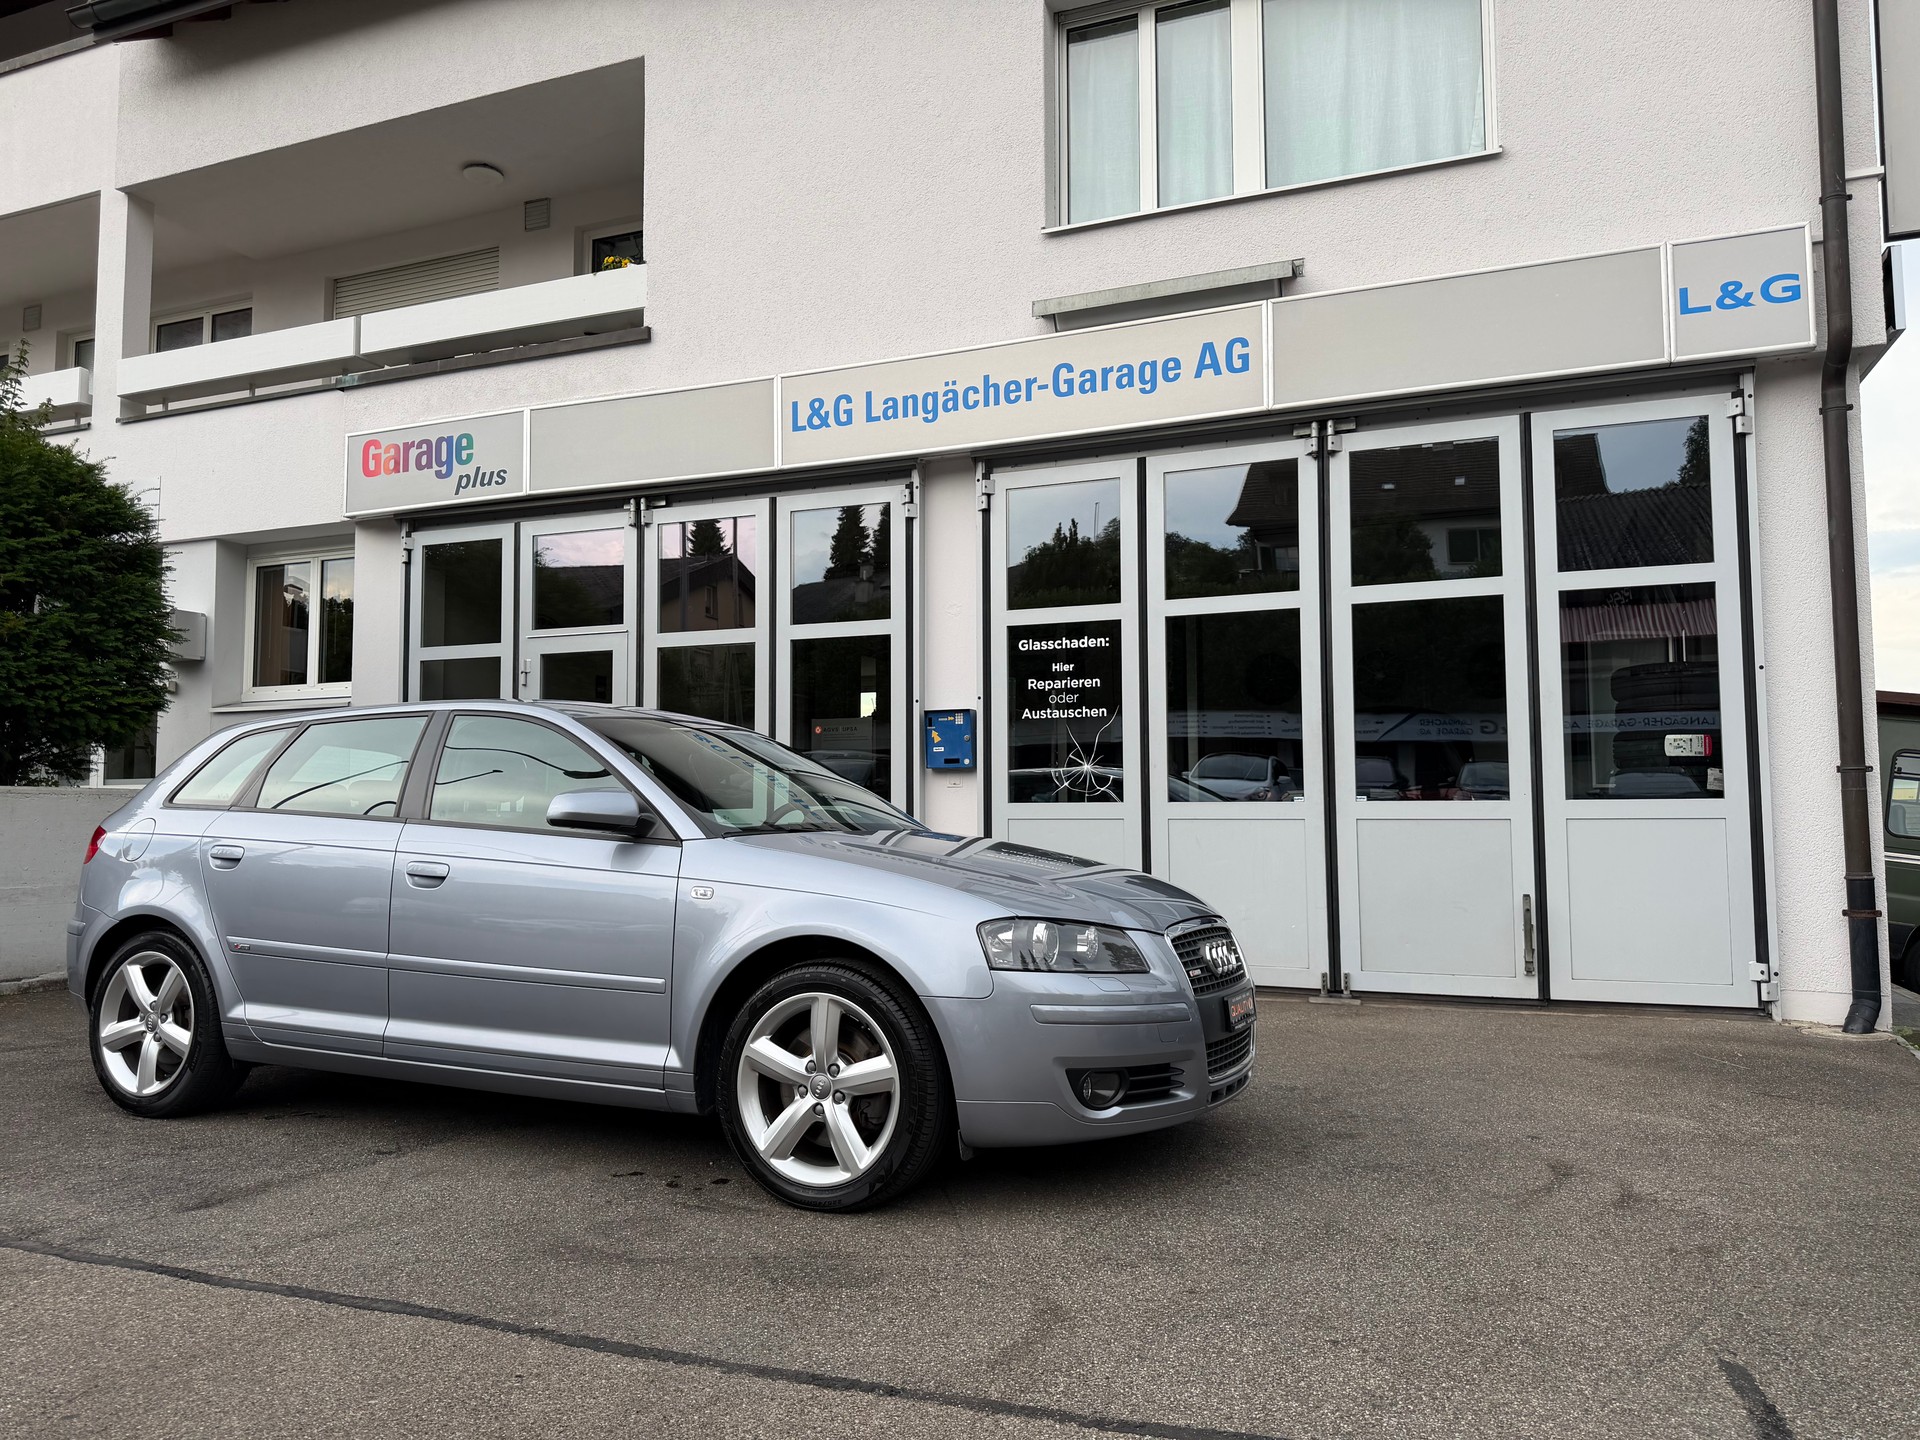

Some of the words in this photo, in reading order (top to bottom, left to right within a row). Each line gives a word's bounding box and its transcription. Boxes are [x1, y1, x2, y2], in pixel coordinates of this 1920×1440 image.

[1678, 272, 1802, 316] L&G
[791, 393, 854, 433] L&G
[865, 357, 1182, 424] Langächer-Garage
[1193, 336, 1251, 380] AG
[361, 432, 474, 480] Garage
[455, 465, 508, 496] plus
[1018, 636, 1110, 652] Glasschaden:
[1051, 662, 1075, 672] Hier
[1027, 676, 1101, 692] Reparieren
[1048, 692, 1079, 704] oder
[1021, 705, 1108, 720] Austauschen
